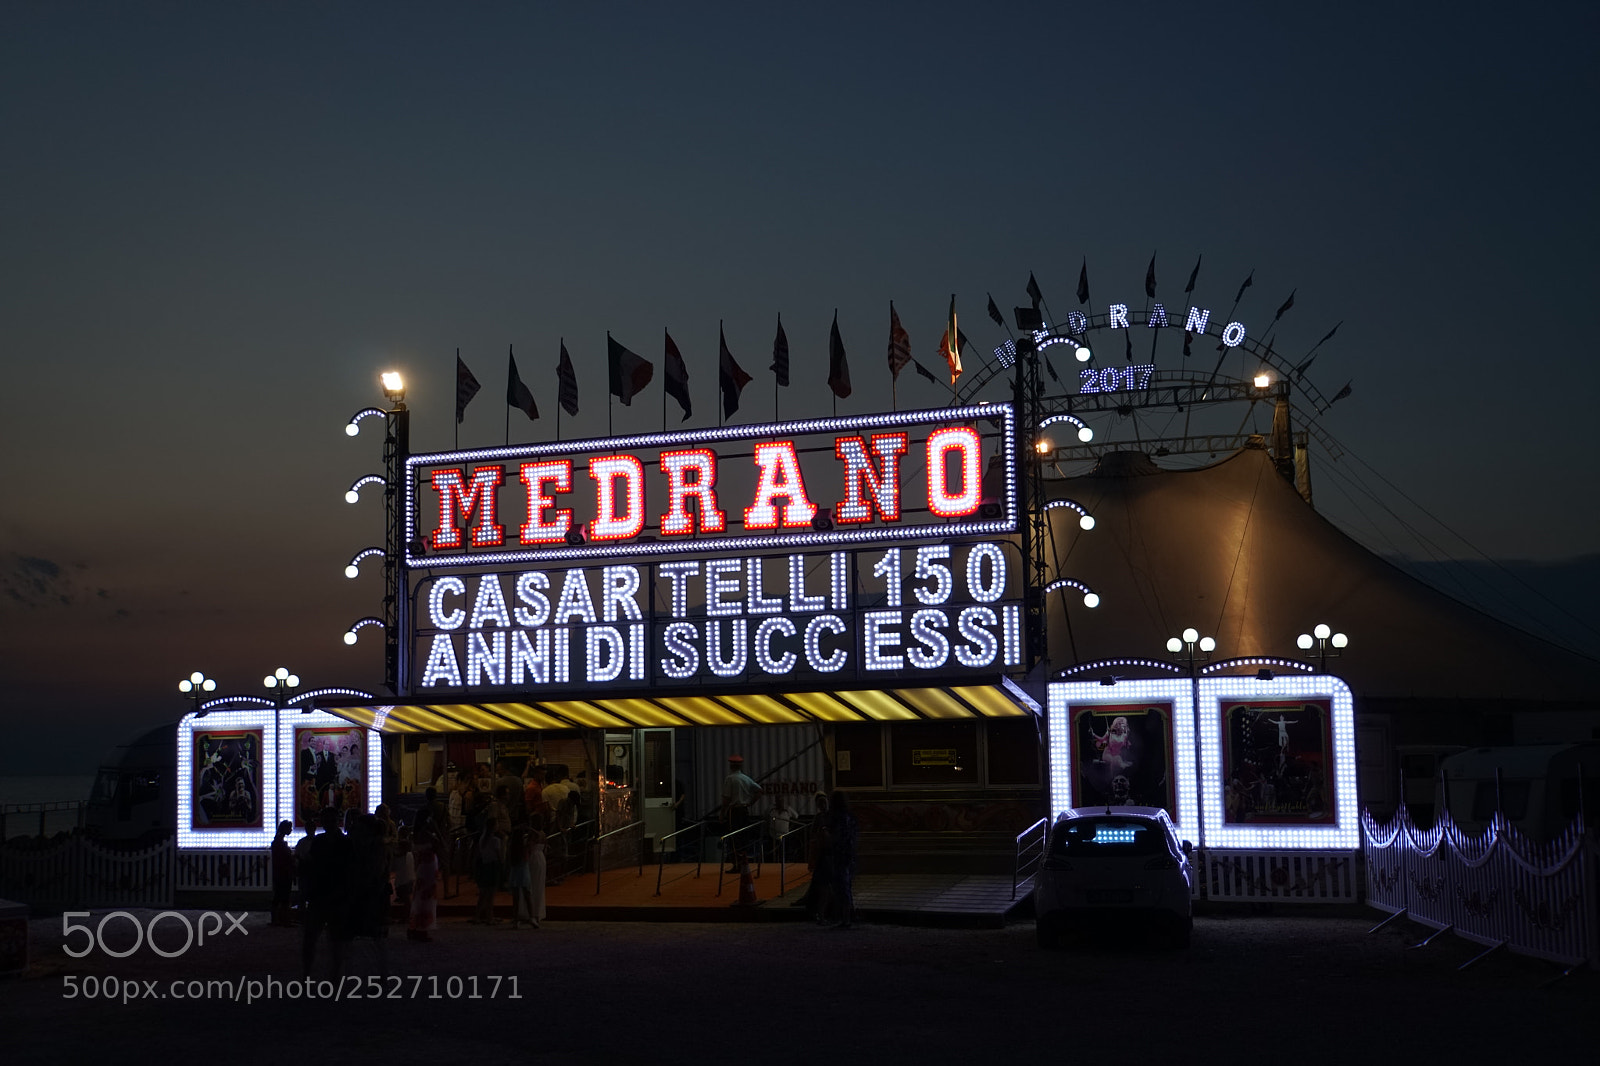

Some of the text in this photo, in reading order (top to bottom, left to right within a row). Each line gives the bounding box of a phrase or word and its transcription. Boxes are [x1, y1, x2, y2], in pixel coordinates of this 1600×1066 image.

[1079, 363, 1155, 394] 2017
[430, 425, 983, 549] MEDRANO
[873, 542, 1007, 607] 150
[421, 625, 570, 688] ANNI
[586, 623, 645, 683] DI
